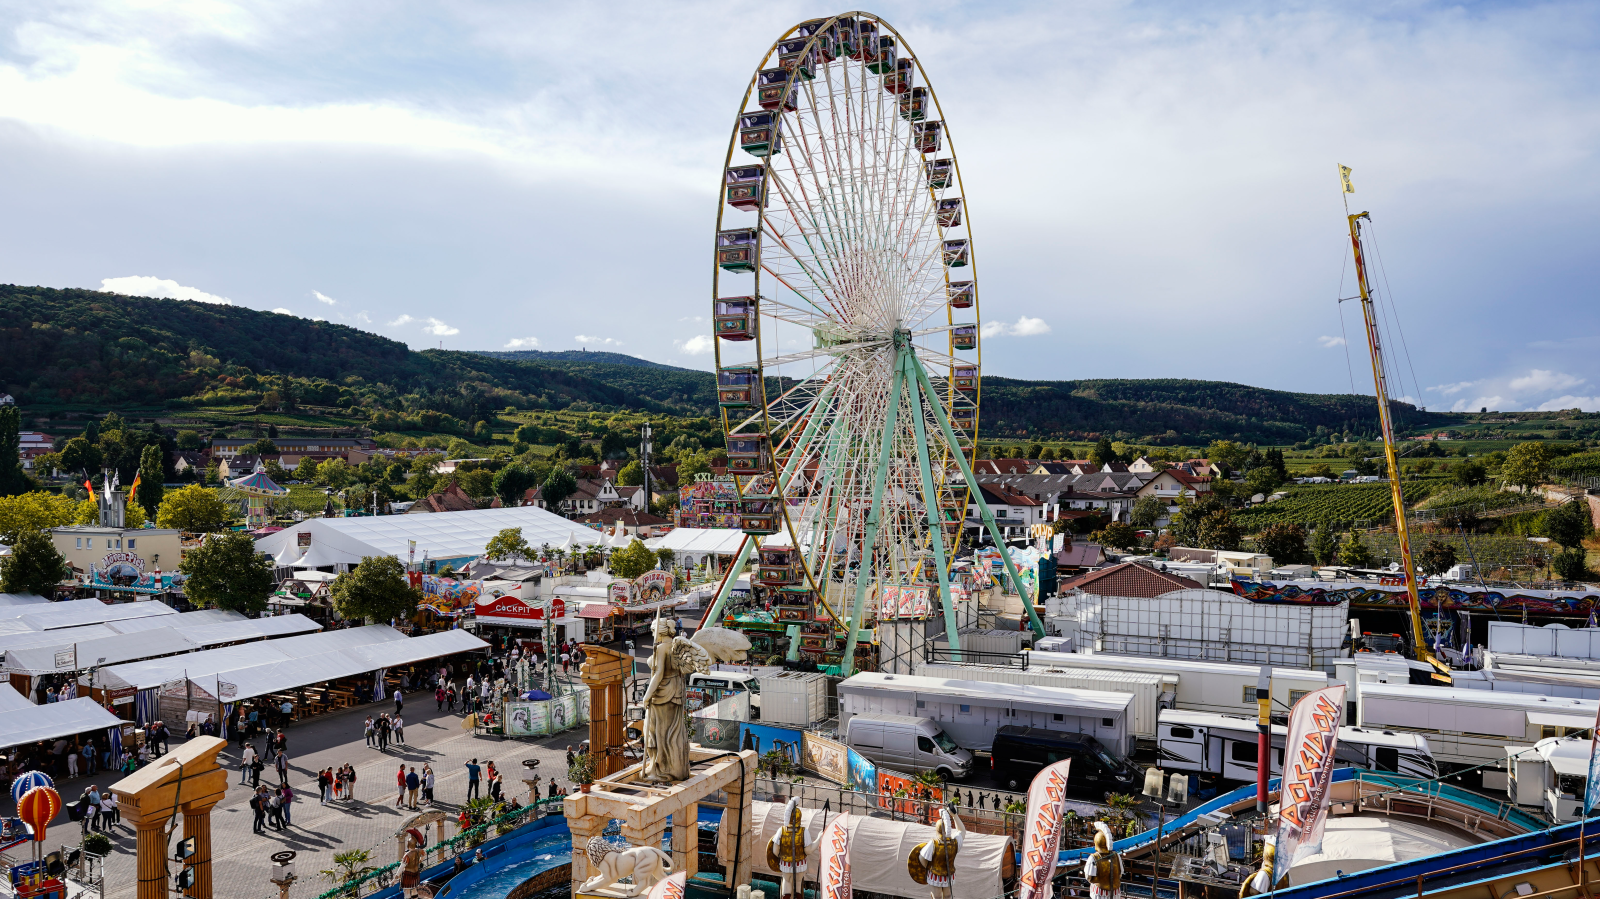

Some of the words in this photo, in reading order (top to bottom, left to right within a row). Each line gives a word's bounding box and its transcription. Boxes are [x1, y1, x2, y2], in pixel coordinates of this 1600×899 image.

[693, 472, 713, 482] XXL
[1031, 523, 1054, 541] POLYP
[644, 574, 665, 584] PIZZA
[495, 604, 531, 613] COCKPIT
[1280, 695, 1338, 829] POSEIDON
[1313, 787, 1323, 801] DER
[1308, 802, 1319, 823] REICH
[1021, 769, 1065, 889] POSEIDON
[1304, 824, 1312, 834] IM
